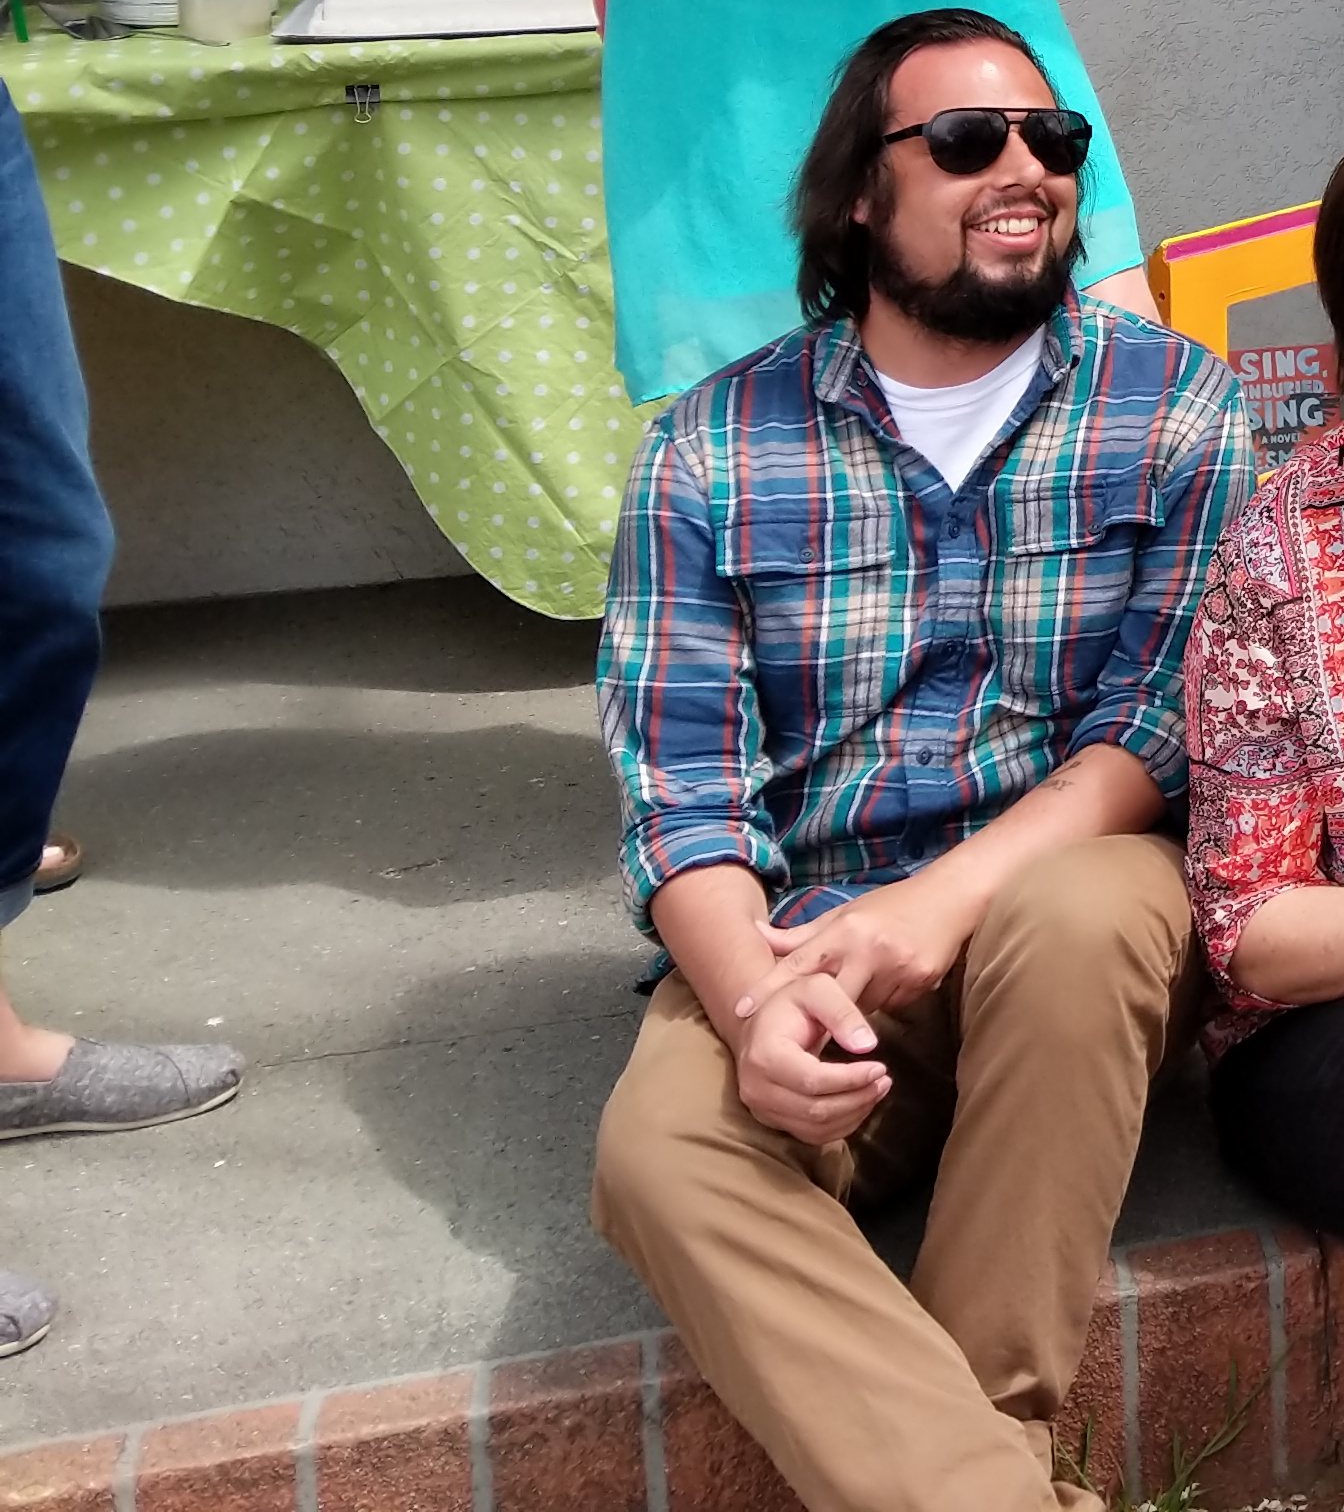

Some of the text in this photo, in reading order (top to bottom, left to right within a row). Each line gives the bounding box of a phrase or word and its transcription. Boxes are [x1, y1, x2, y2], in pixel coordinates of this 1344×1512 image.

[1236, 348, 1328, 381] SING,
[1248, 397, 1325, 431] SING
[1261, 433, 1303, 445] A NOVEL
